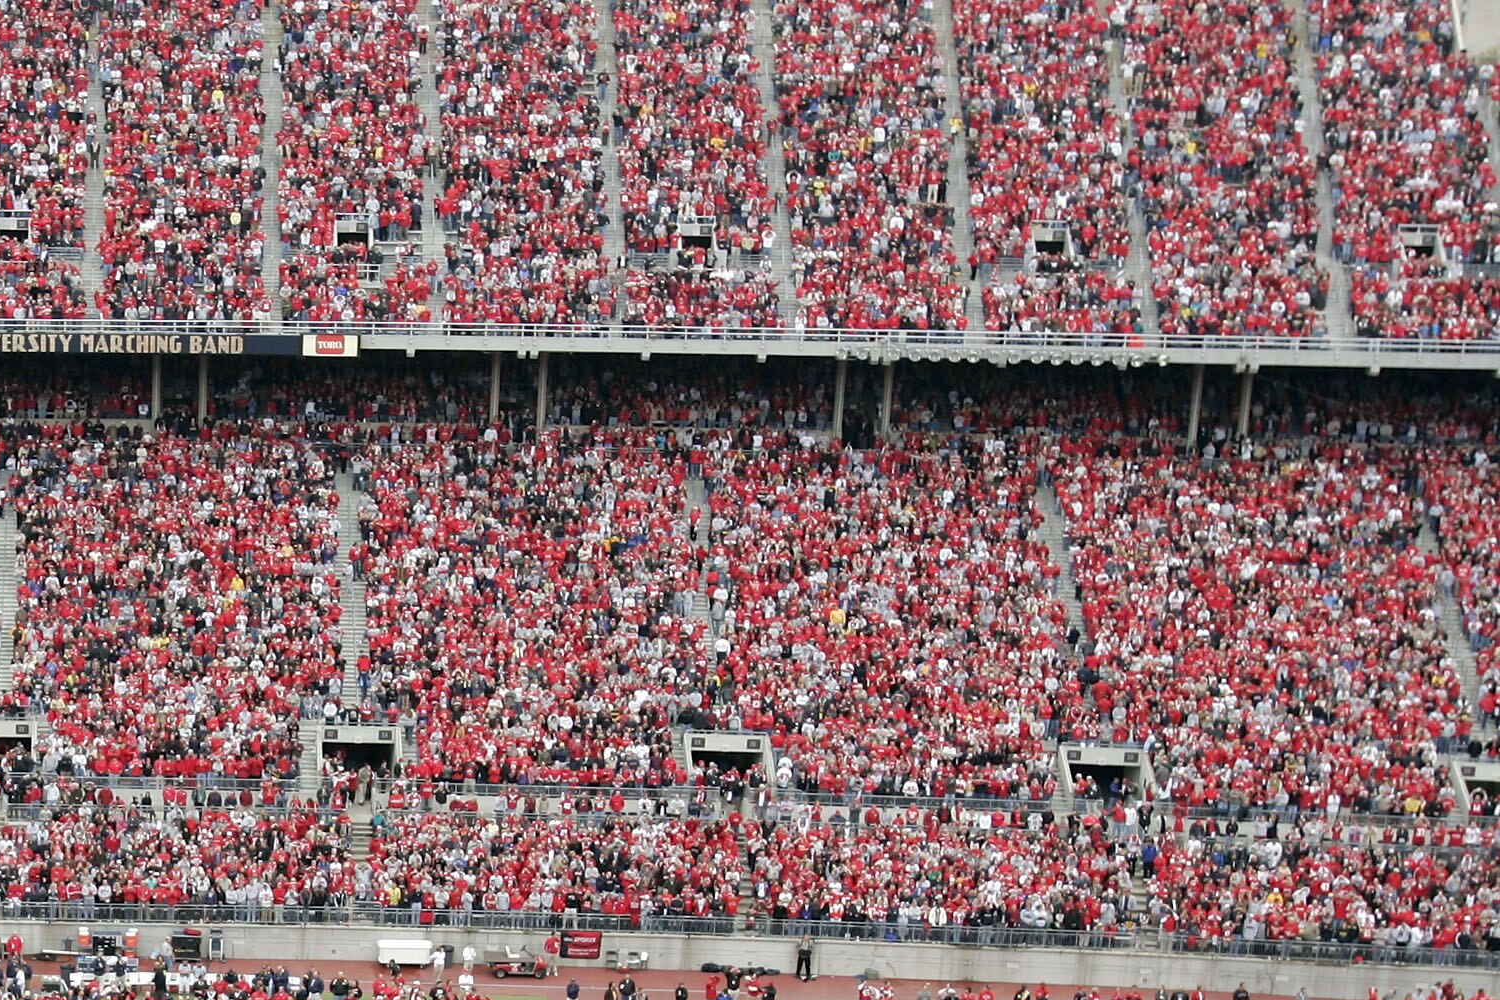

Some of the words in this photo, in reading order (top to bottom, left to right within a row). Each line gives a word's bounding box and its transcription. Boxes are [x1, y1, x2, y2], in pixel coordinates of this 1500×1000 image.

[79, 334, 183, 354] MARCHING
[189, 335, 245, 355] BAND
[316, 339, 343, 350] TORO
